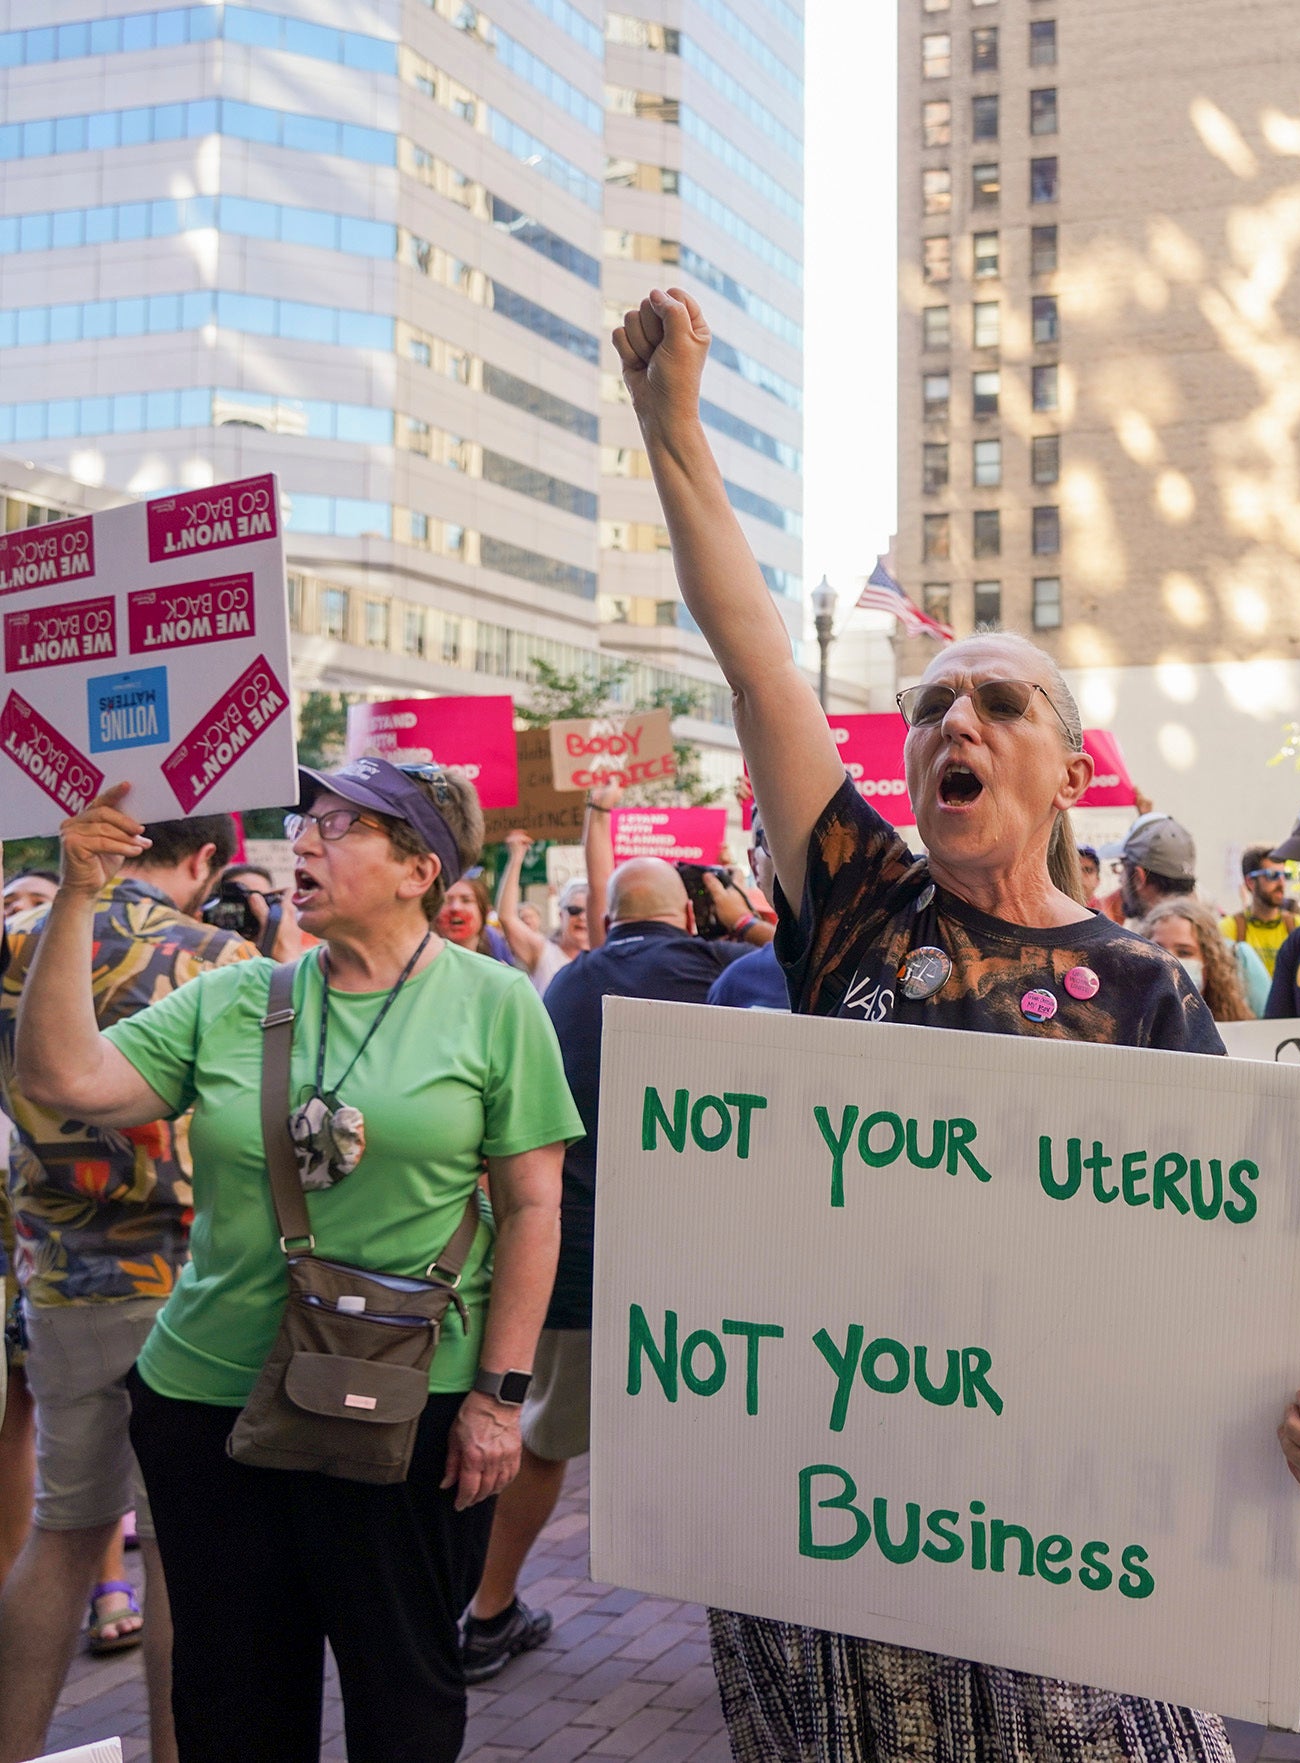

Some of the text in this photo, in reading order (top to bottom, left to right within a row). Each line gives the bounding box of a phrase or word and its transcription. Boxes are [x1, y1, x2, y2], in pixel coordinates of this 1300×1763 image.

[180, 496, 234, 526] BACK.
[238, 489, 270, 514] GO
[61, 530, 89, 555] GO
[164, 512, 272, 553] WE WON'T
[60, 552, 91, 577] WE
[160, 593, 212, 621] BACK.
[216, 587, 249, 612] GO
[84, 610, 112, 633] GO
[143, 611, 251, 647] WE WON'T
[18, 632, 114, 665] WE WON'T
[99, 689, 156, 711] MATTERS
[241, 673, 271, 708] GO
[100, 704, 159, 743] VOTING
[247, 690, 284, 731] WE
[566, 725, 643, 758] BODY
[4, 731, 59, 793] WON'T
[190, 724, 253, 796] WON'T
[68, 765, 94, 797] GO
[641, 1086, 767, 1159] NOT
[813, 1105, 992, 1207] YOUR
[626, 1303, 1004, 1432] NOT YOUR
